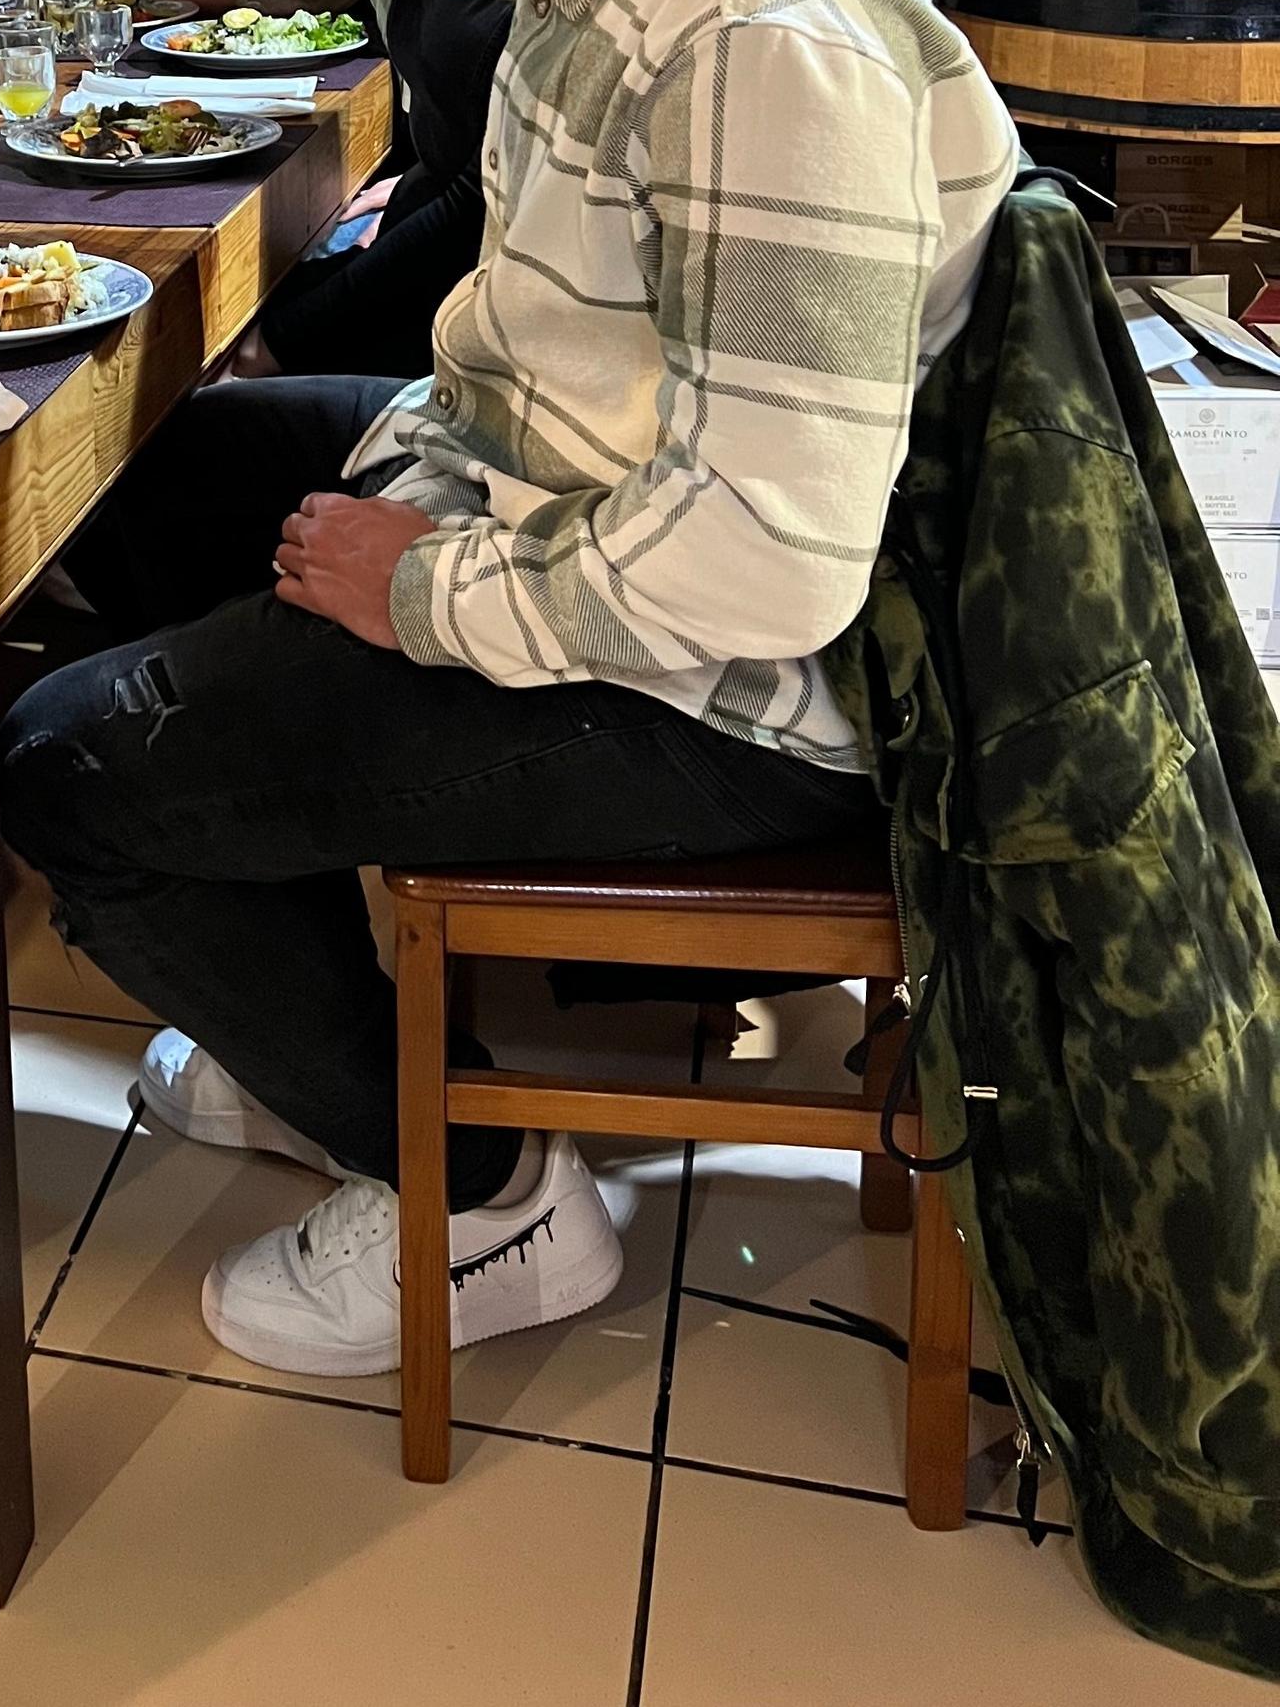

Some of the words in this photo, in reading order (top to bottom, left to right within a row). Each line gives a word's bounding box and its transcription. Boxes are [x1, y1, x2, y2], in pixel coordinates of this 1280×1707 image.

[1146, 155, 1214, 166] BORGES
[1168, 429, 1207, 439] RAMOS
[1213, 429, 1248, 439] PINTO
[1225, 572, 1248, 580] NTO
